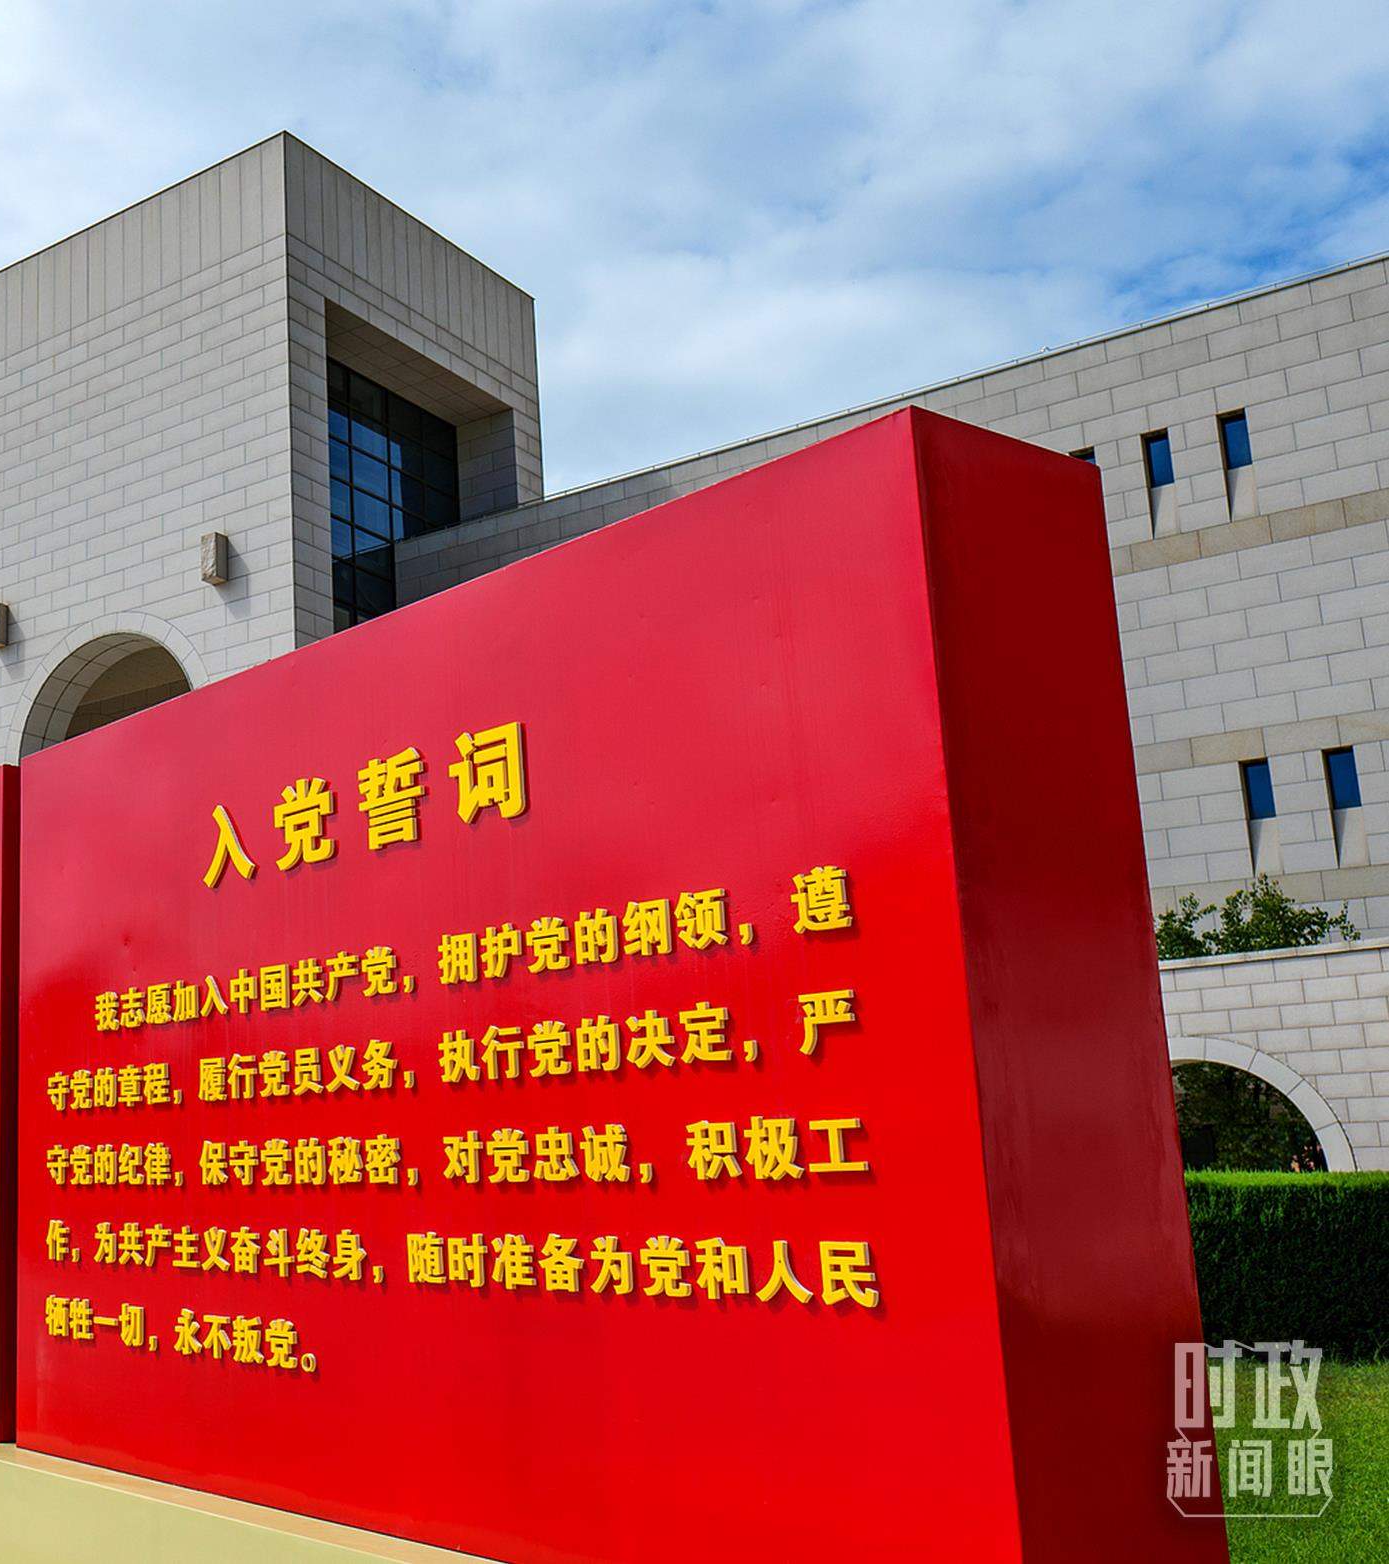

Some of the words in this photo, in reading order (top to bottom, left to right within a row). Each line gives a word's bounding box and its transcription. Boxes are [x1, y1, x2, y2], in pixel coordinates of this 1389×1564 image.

[202, 720, 529, 889] 入党誓词
[44, 1294, 318, 1373] 牺牲一切，永不叛党。
